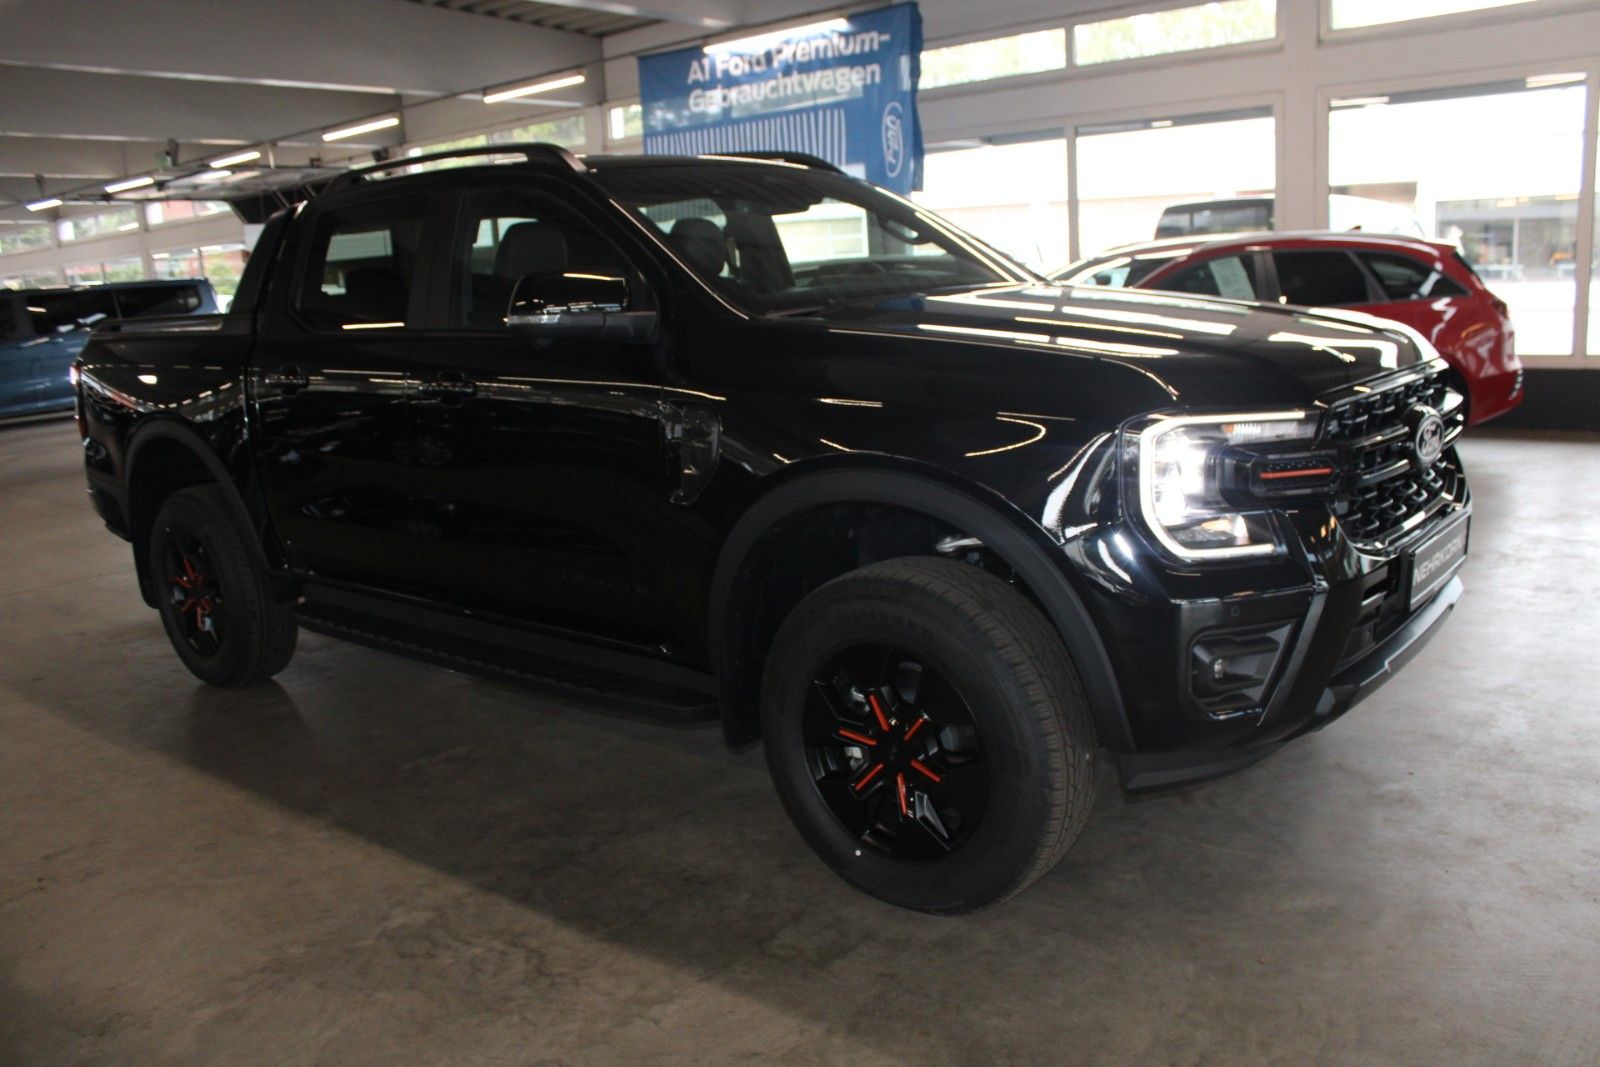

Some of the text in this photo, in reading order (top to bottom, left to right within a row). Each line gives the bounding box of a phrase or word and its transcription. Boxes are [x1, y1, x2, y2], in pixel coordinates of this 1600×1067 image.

[715, 49, 767, 78] Ford
[771, 30, 891, 69] Premium-
[687, 62, 881, 113] Gebrauchtwagen
